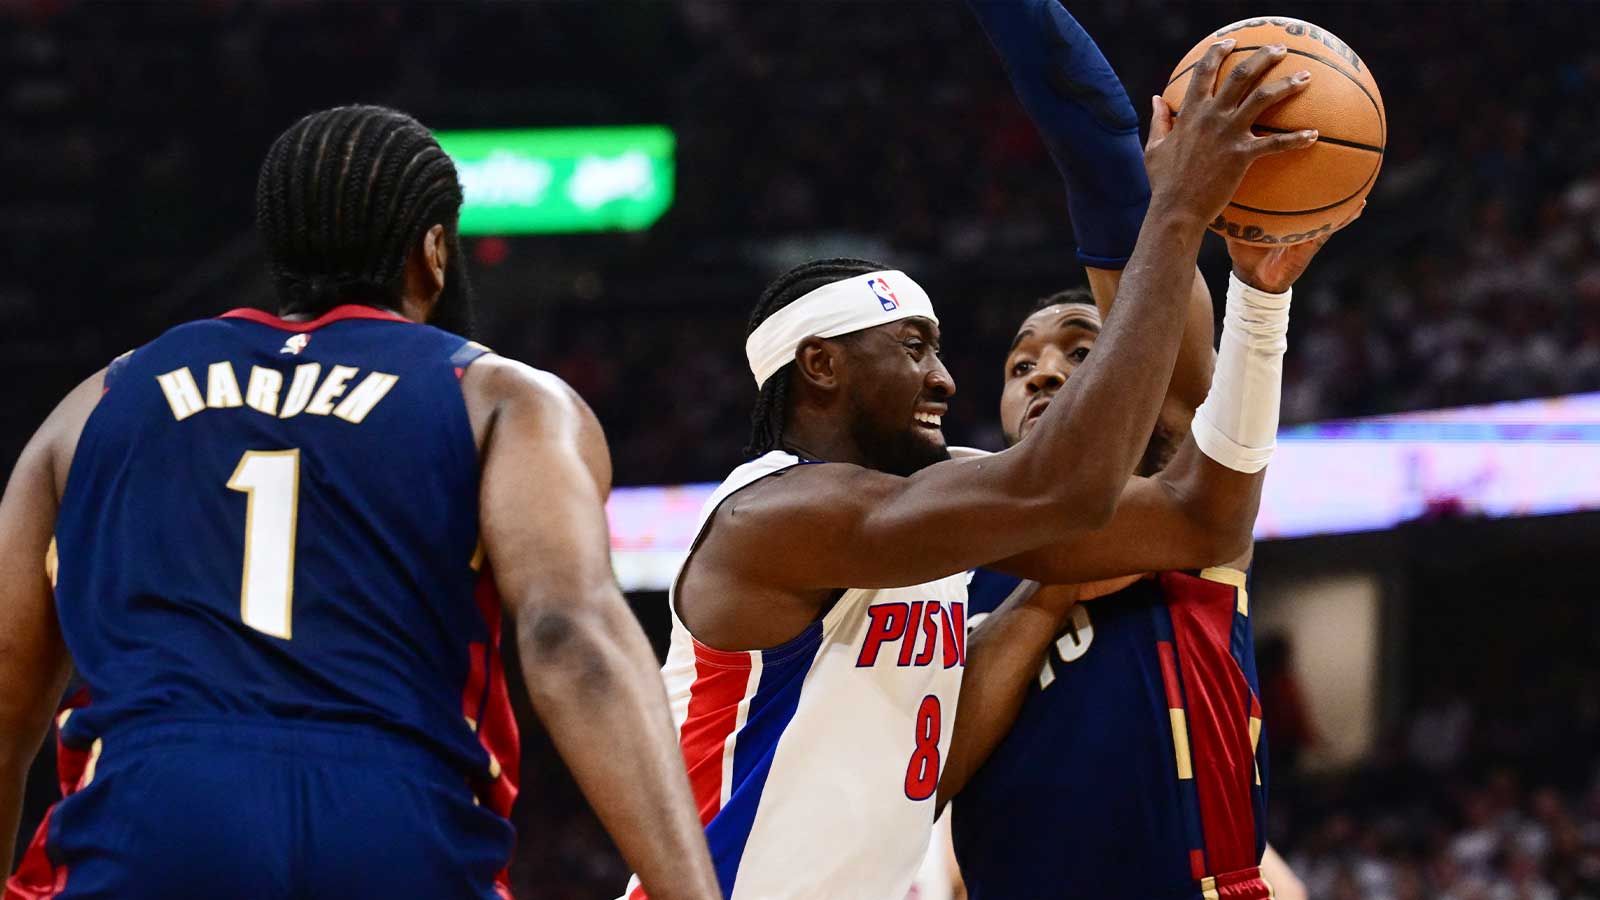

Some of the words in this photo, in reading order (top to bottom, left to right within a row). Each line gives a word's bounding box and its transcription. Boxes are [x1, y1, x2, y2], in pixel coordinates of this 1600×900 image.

[156, 361, 400, 424] HARDEN
[226, 448, 299, 640] 1
[904, 694, 941, 801] 8
